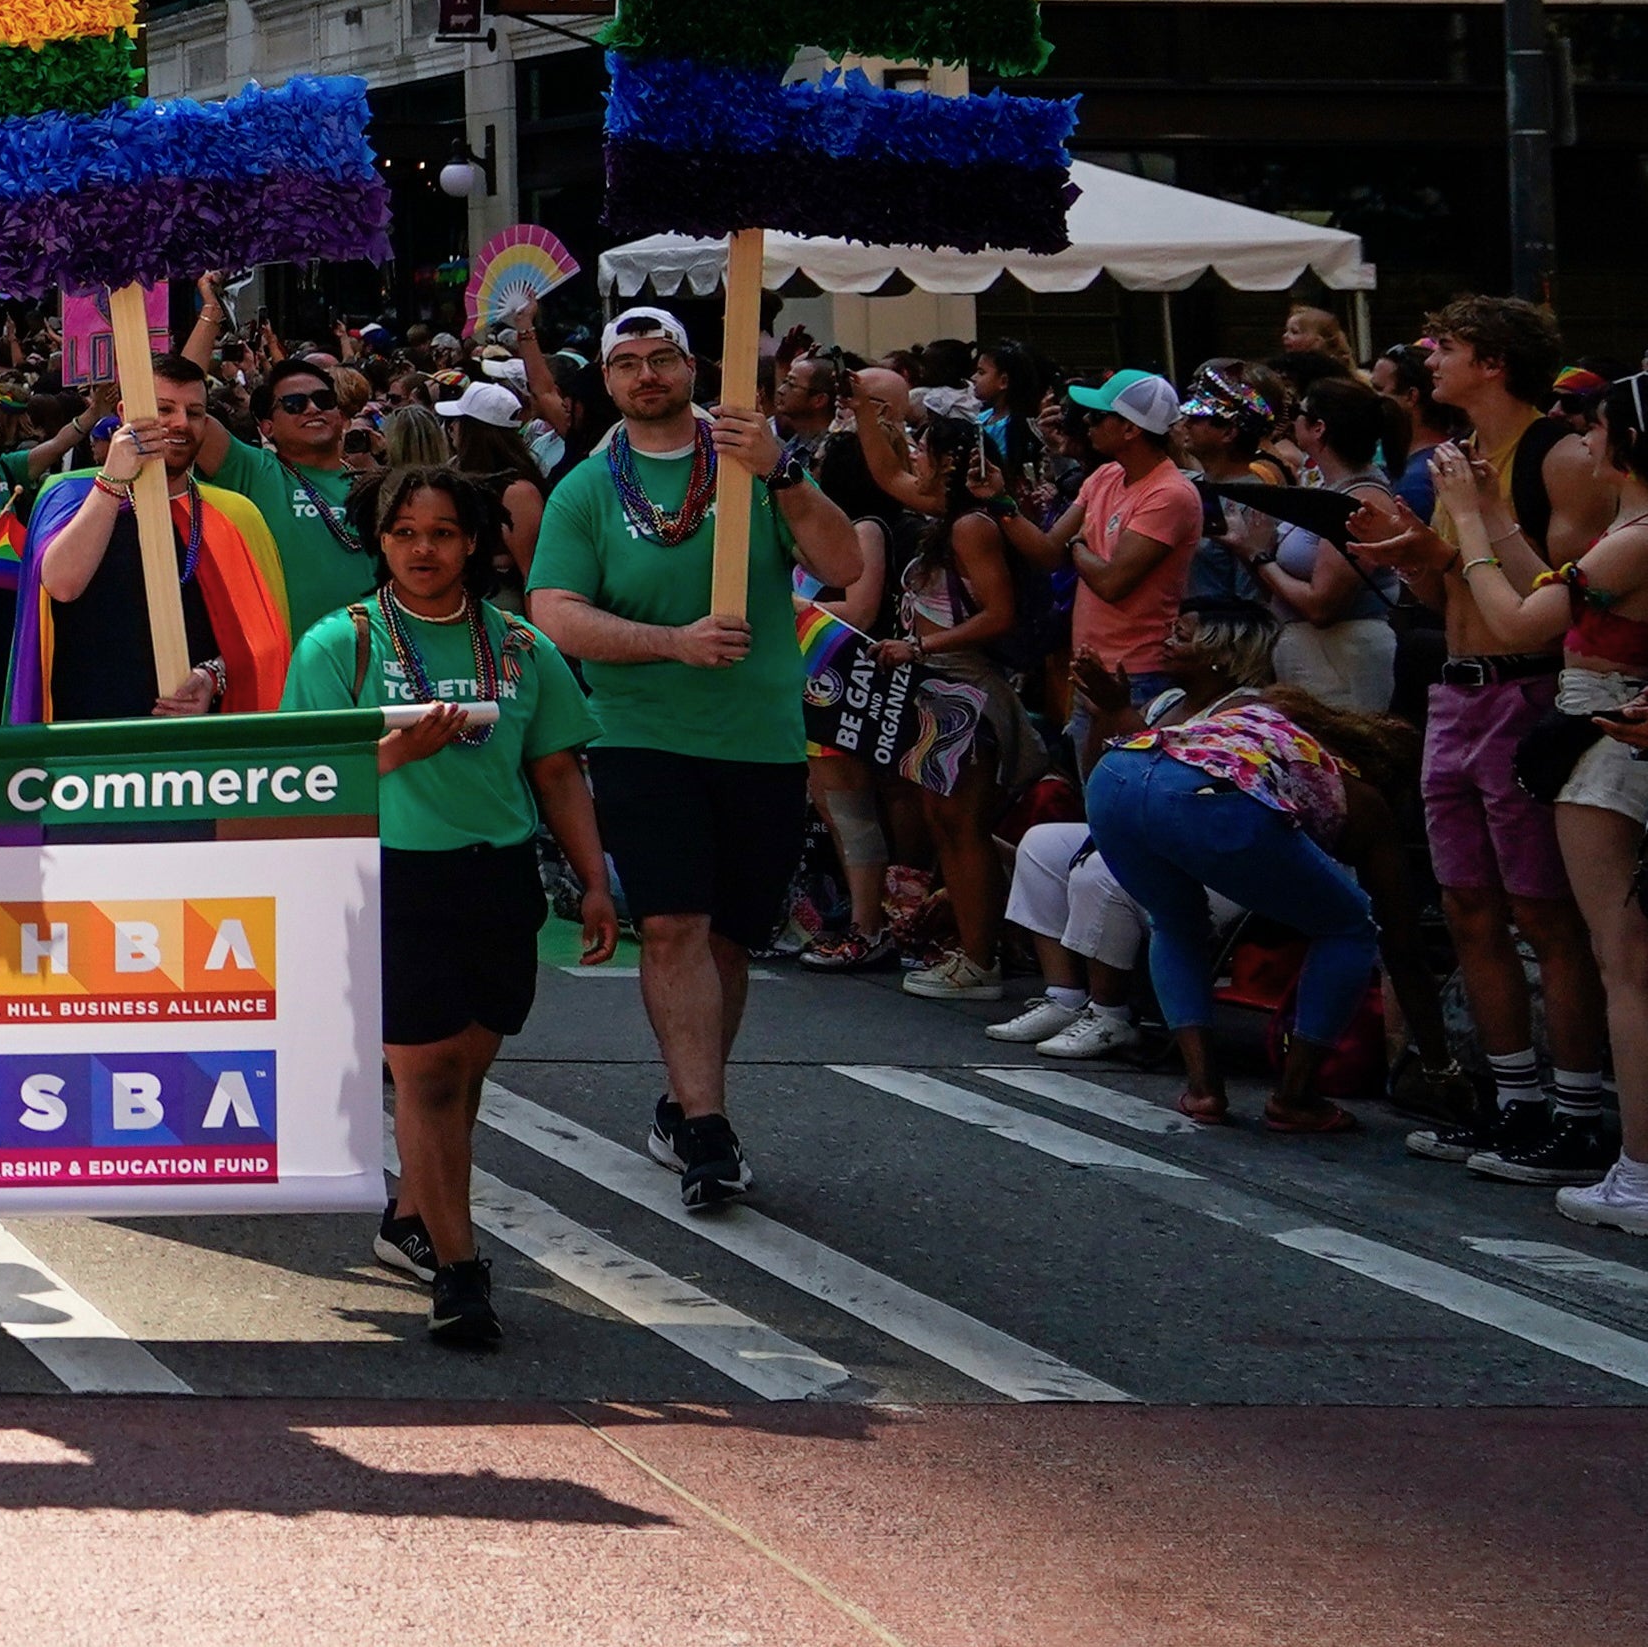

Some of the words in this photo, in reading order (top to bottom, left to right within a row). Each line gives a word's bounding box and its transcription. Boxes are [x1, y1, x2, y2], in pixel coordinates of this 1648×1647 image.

[846, 647, 877, 710] GAY
[867, 692, 884, 722] AND
[874, 661, 912, 765] ORGANIZE
[835, 712, 863, 751] BE
[7, 765, 339, 811] Commerce
[7, 1001, 52, 1017] HILL
[59, 1000, 159, 1016] BUSINESS
[167, 998, 267, 1014] ALLIANCE
[68, 1160, 82, 1176] &
[88, 1158, 207, 1176] EDUCATION
[214, 1157, 269, 1173] FUND
